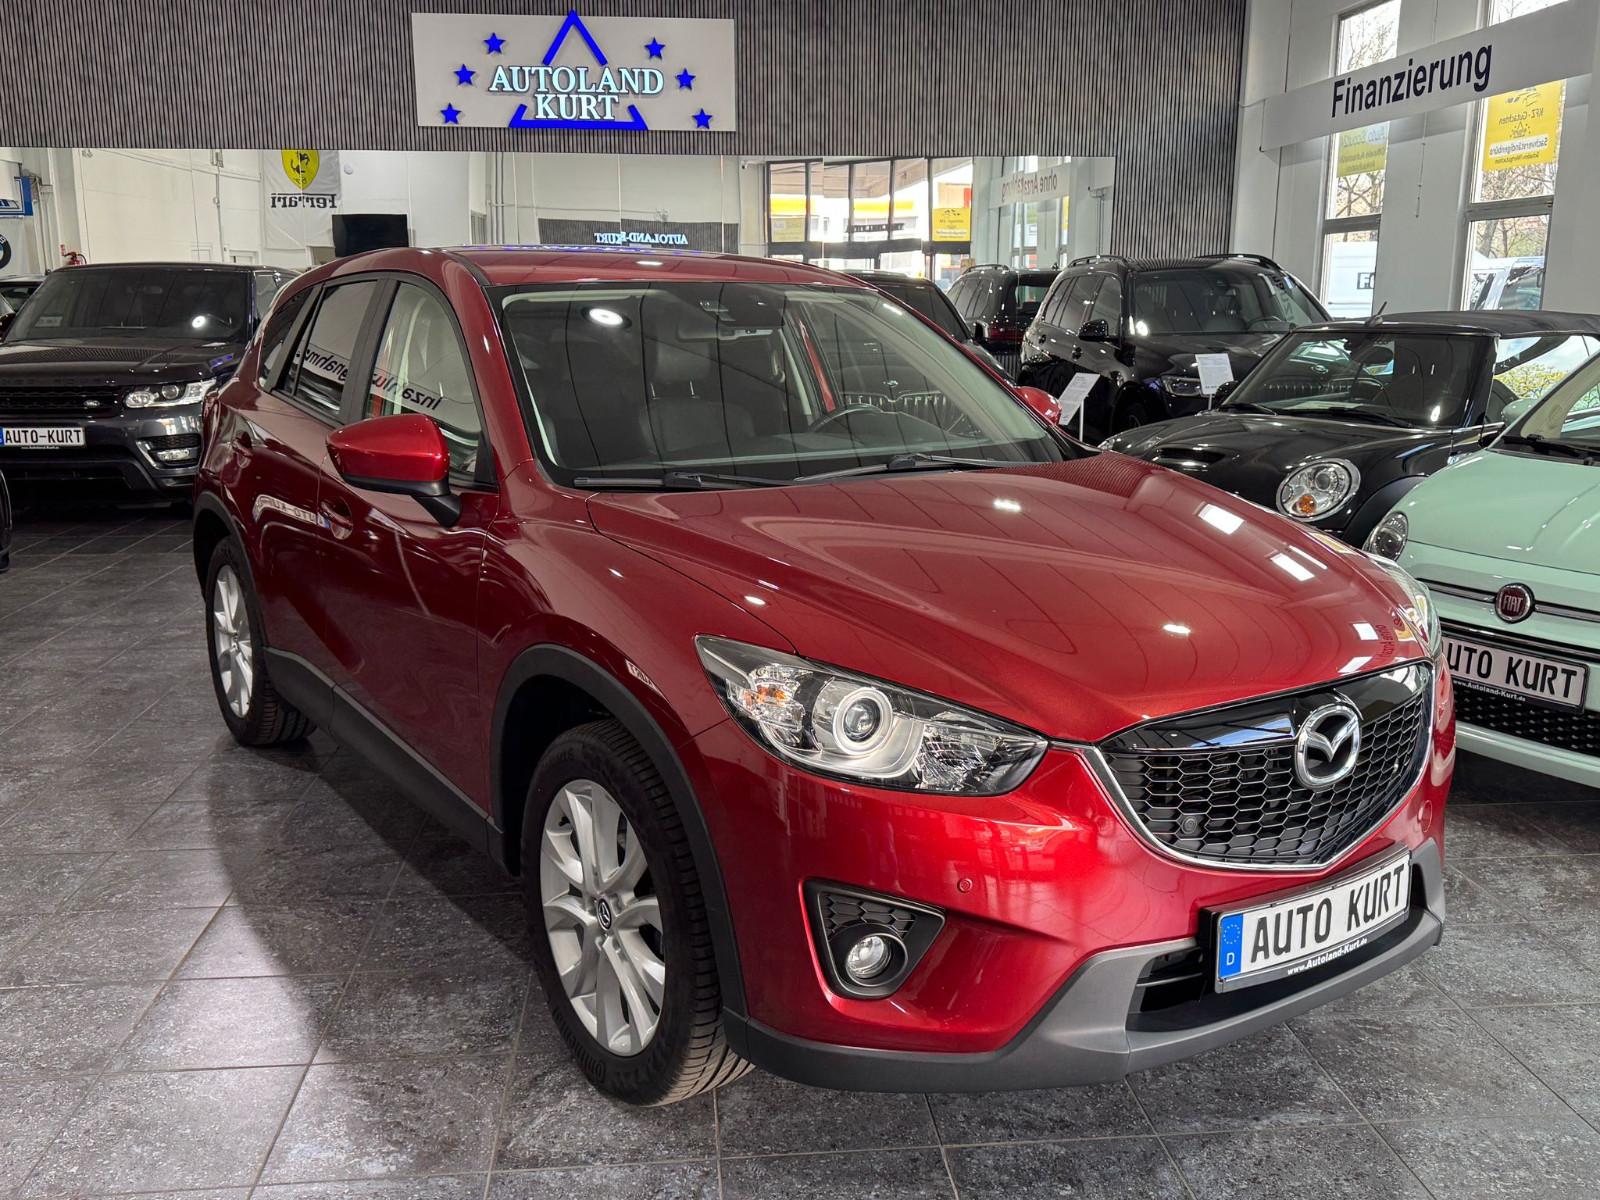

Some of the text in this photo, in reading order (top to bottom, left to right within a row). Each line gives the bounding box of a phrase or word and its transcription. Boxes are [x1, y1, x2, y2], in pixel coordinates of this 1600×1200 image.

[488, 65, 664, 95] AUTOLAND
[1331, 44, 1493, 118] Finanzierung
[534, 93, 619, 121] KURT
[5, 429, 82, 444] AUTO-KURT
[1503, 594, 1524, 613] FIAT
[1446, 642, 1578, 699] UTO KURT
[1226, 863, 1405, 966] D AUTO KURT
[1286, 937, 1369, 976] www.Autoland-Kurt.de
